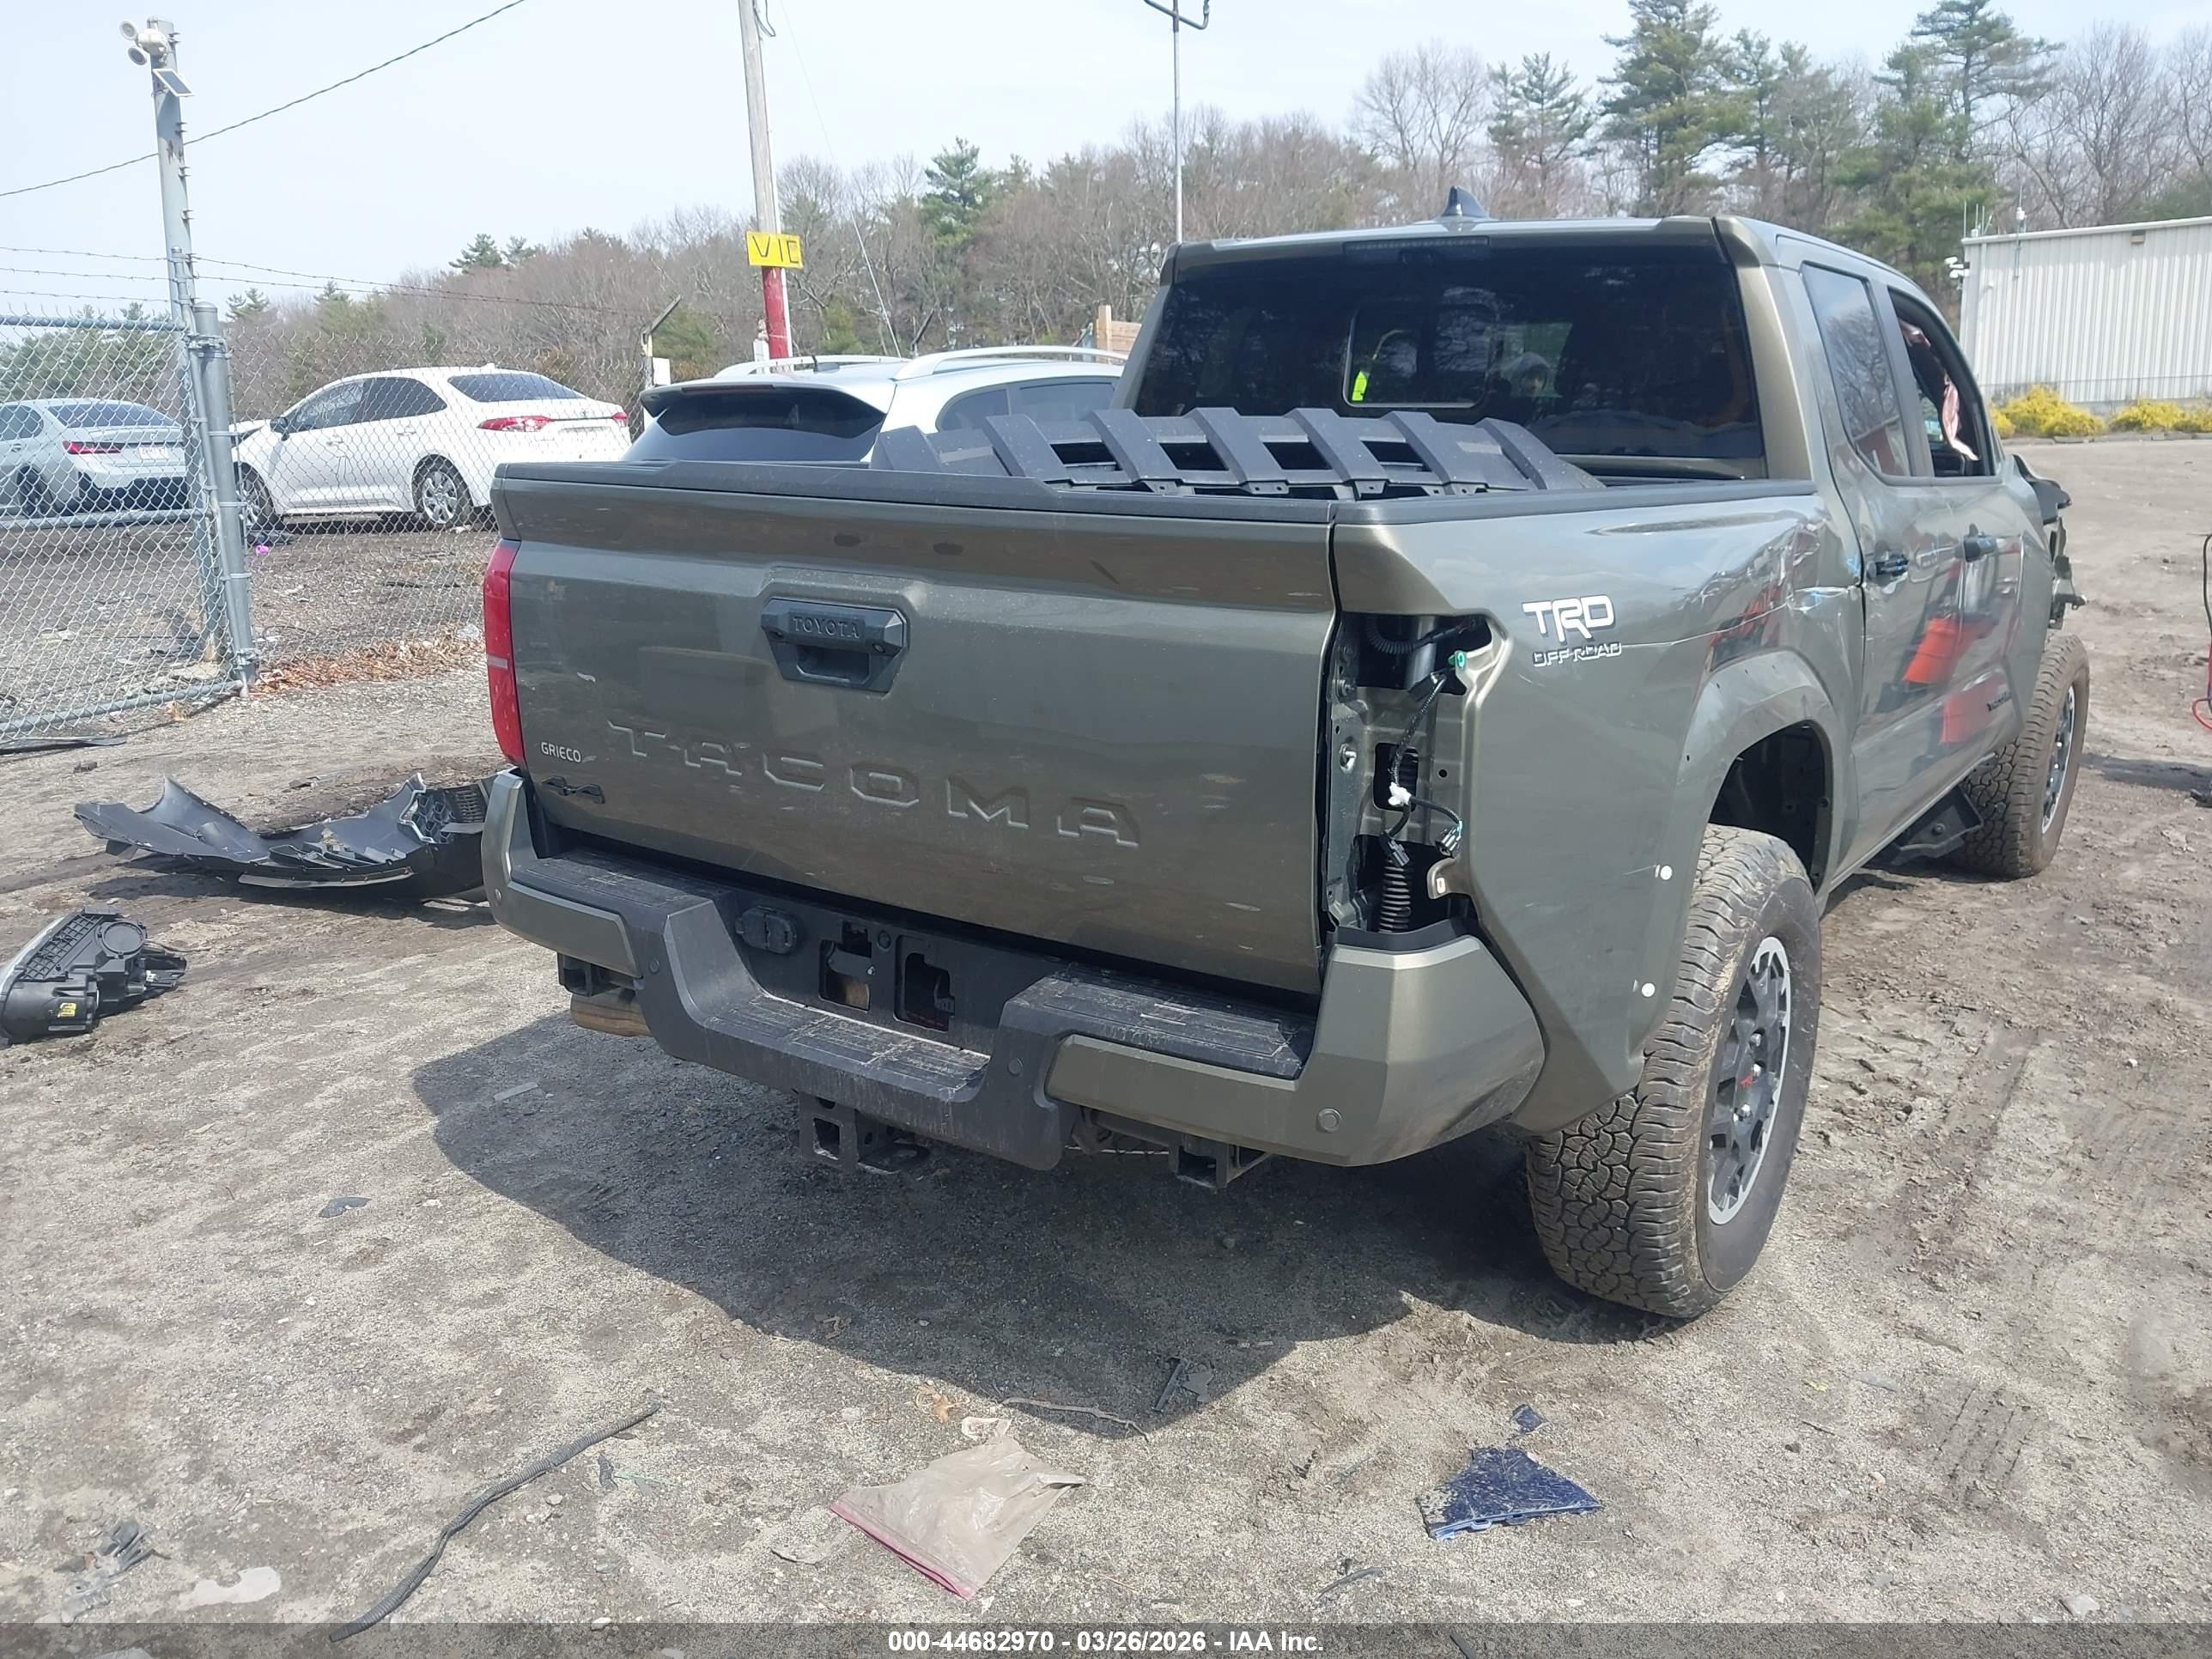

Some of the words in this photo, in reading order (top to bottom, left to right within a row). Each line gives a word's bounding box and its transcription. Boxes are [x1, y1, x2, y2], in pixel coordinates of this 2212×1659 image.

[793, 616, 860, 639] TOYOTA
[1522, 594, 1614, 642] TRD
[540, 741, 582, 763] GRIECO
[607, 719, 1141, 848] TACOMA
